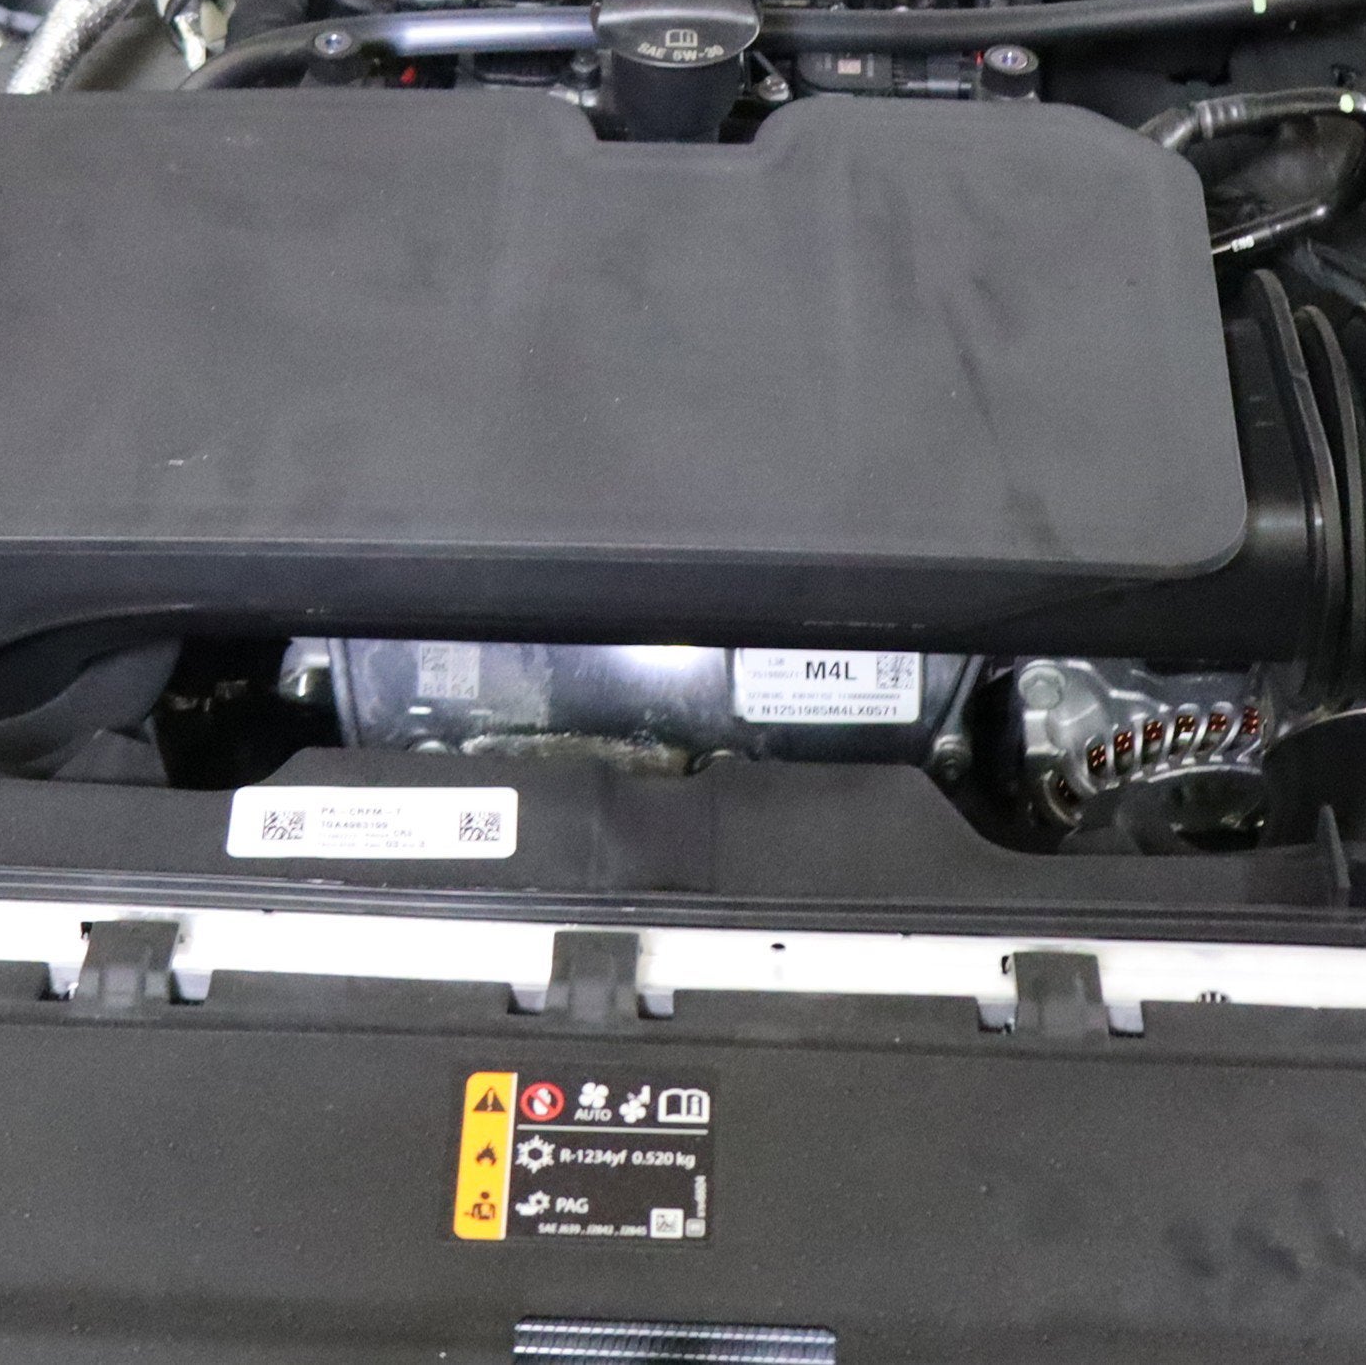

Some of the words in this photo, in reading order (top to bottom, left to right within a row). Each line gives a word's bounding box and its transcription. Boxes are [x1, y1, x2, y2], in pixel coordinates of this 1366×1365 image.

[637, 41, 667, 60] SAE
[805, 661, 858, 681] M4L
[574, 1108, 612, 1122] AUTO
[559, 1148, 628, 1168] R-1234yf
[632, 1151, 674, 1166] 0.520
[675, 1151, 696, 1170] kg
[554, 1197, 589, 1214] PAG
